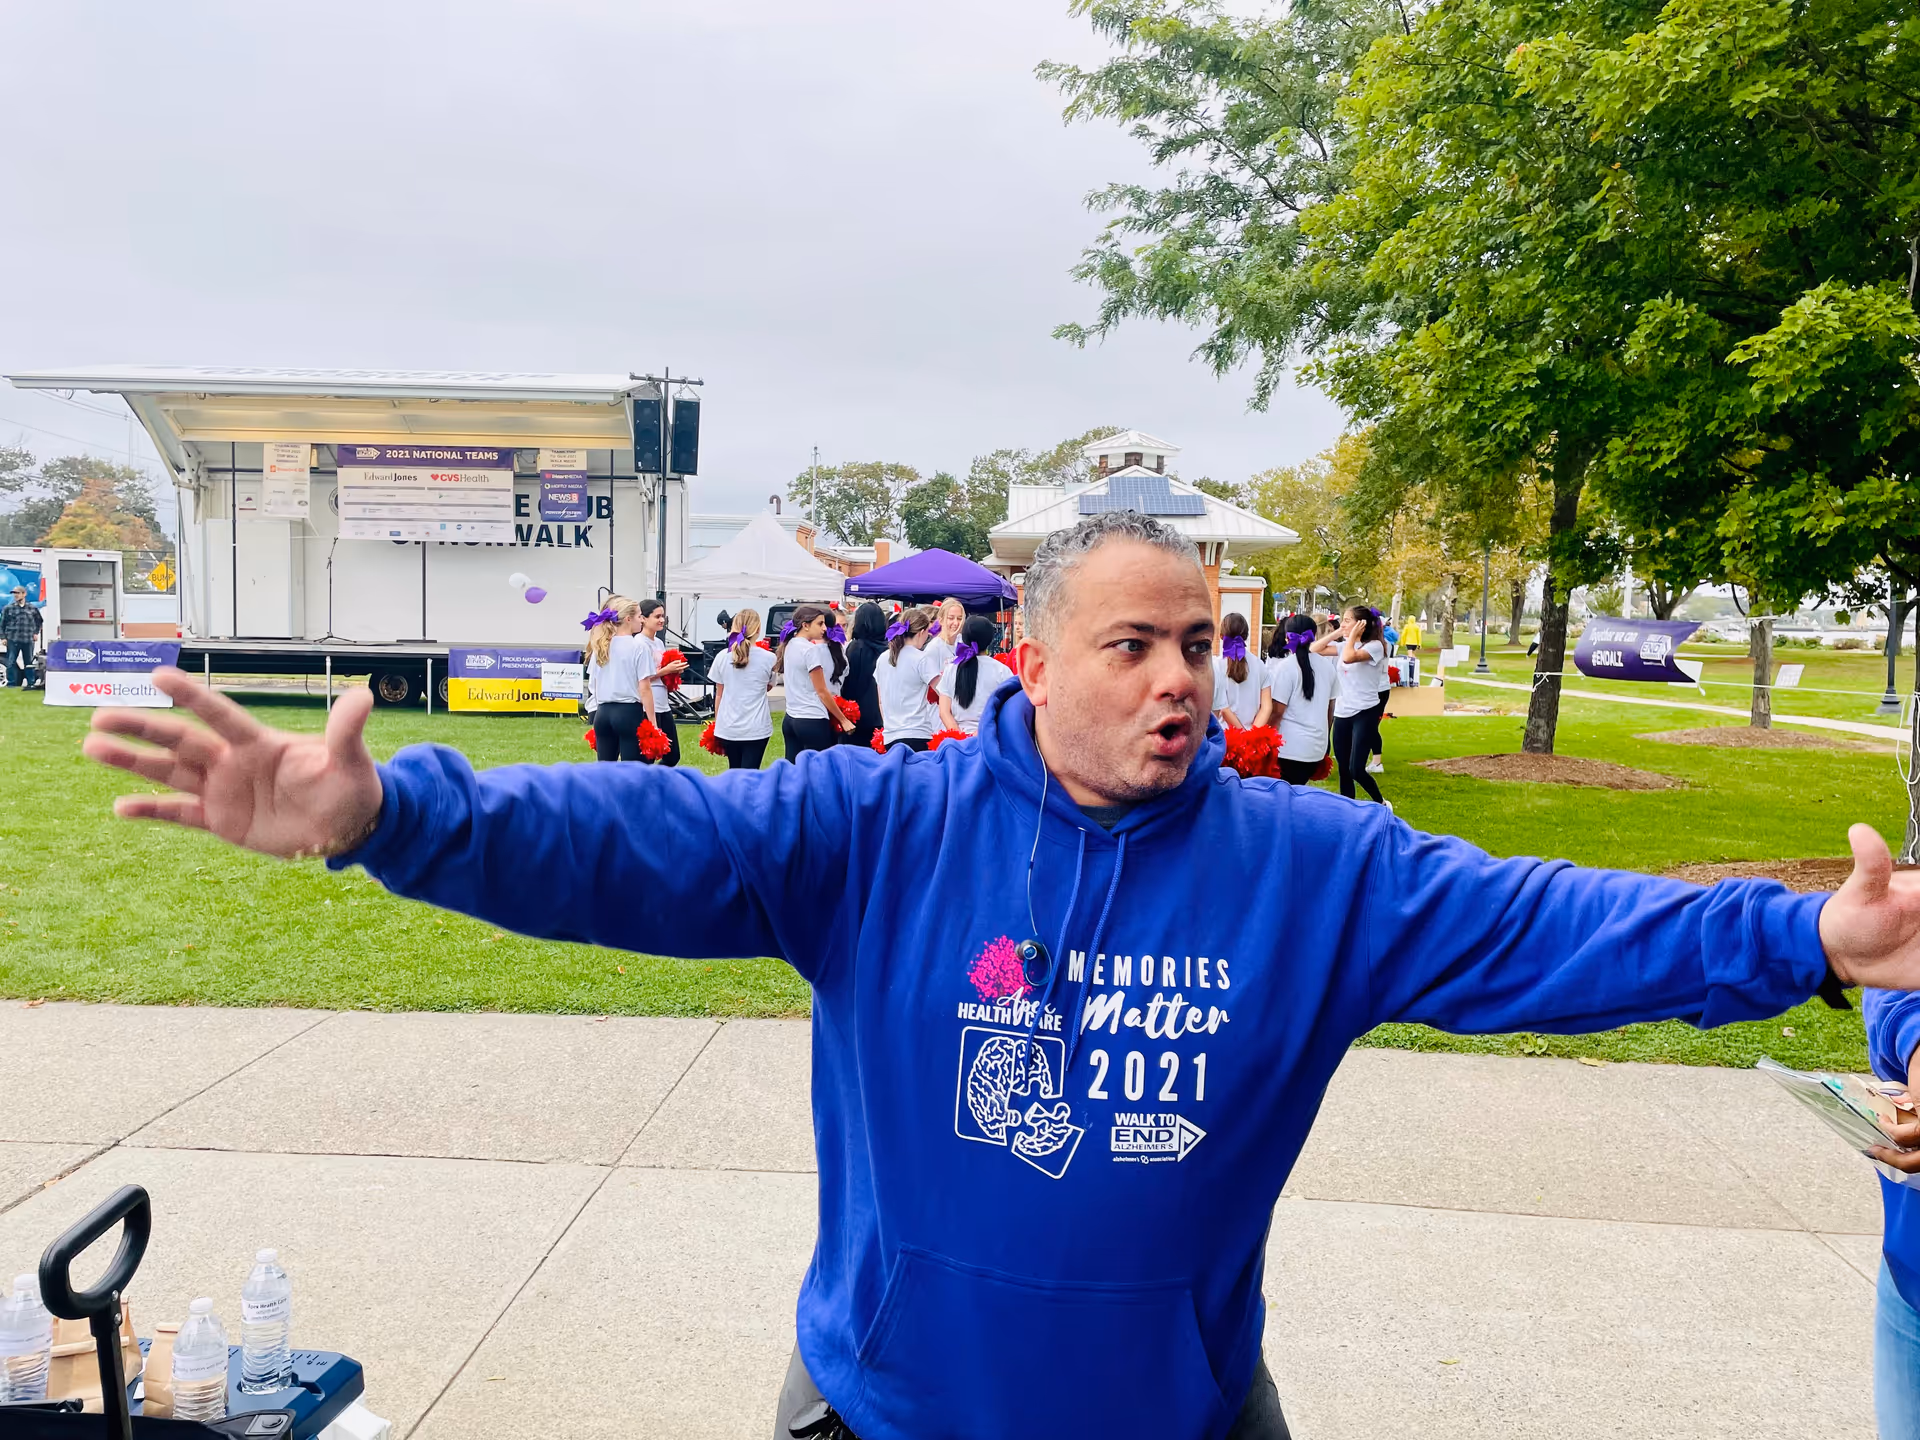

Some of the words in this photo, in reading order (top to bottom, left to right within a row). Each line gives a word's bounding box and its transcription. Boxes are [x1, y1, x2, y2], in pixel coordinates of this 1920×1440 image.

[386, 450, 410, 458] 2021
[413, 450, 462, 460] NATIONAL
[465, 452, 498, 460] TEAMS
[364, 472, 393, 481] Edward
[393, 473, 418, 482] Jones
[440, 474, 489, 483] CVSHealth
[152, 574, 173, 582] BUMP
[1591, 649, 1624, 667] #ENDALZ
[83, 683, 157, 696] CVSHealth
[468, 688, 514, 700] Edward
[1068, 950, 1230, 990] MEMORIES
[958, 1002, 1012, 1024] HEALTH
[1080, 990, 1230, 1040] Matter
[1088, 1049, 1208, 1102] 2021
[1115, 1112, 1156, 1126] WALK
[1157, 1113, 1175, 1126] TO
[1115, 1129, 1174, 1142] END
